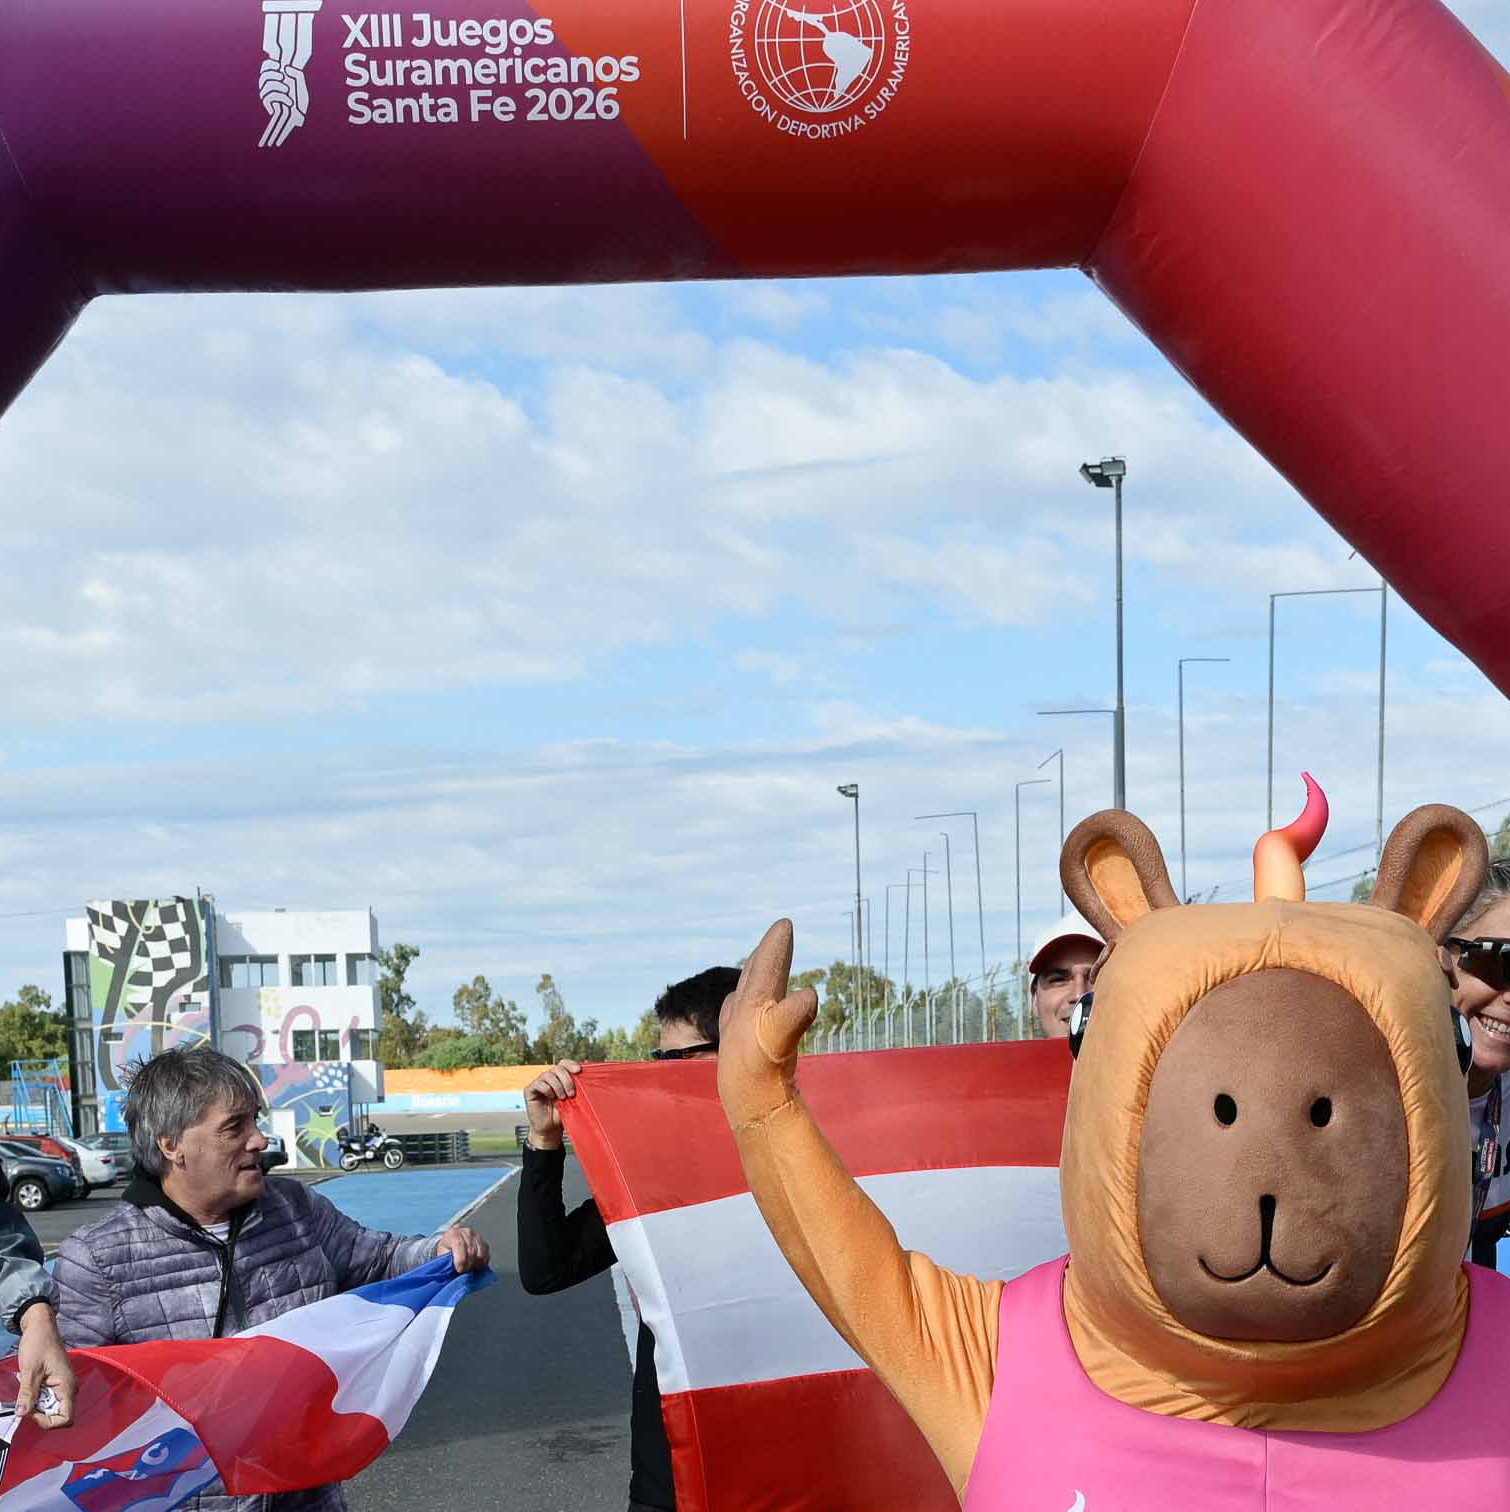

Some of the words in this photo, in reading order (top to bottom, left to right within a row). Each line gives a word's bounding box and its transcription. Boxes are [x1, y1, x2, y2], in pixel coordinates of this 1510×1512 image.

[341, 13, 402, 48] XIII
[411, 13, 554, 54] Juegos
[344, 47, 640, 87] Suramericanos
[729, 0, 777, 123] RGANIZACION
[777, 114, 866, 139] DEPORTIVA
[864, 0, 910, 120] SURAMERICAN
[347, 91, 459, 124] Santa
[470, 89, 517, 122] Fe
[524, 87, 620, 121] 2026
